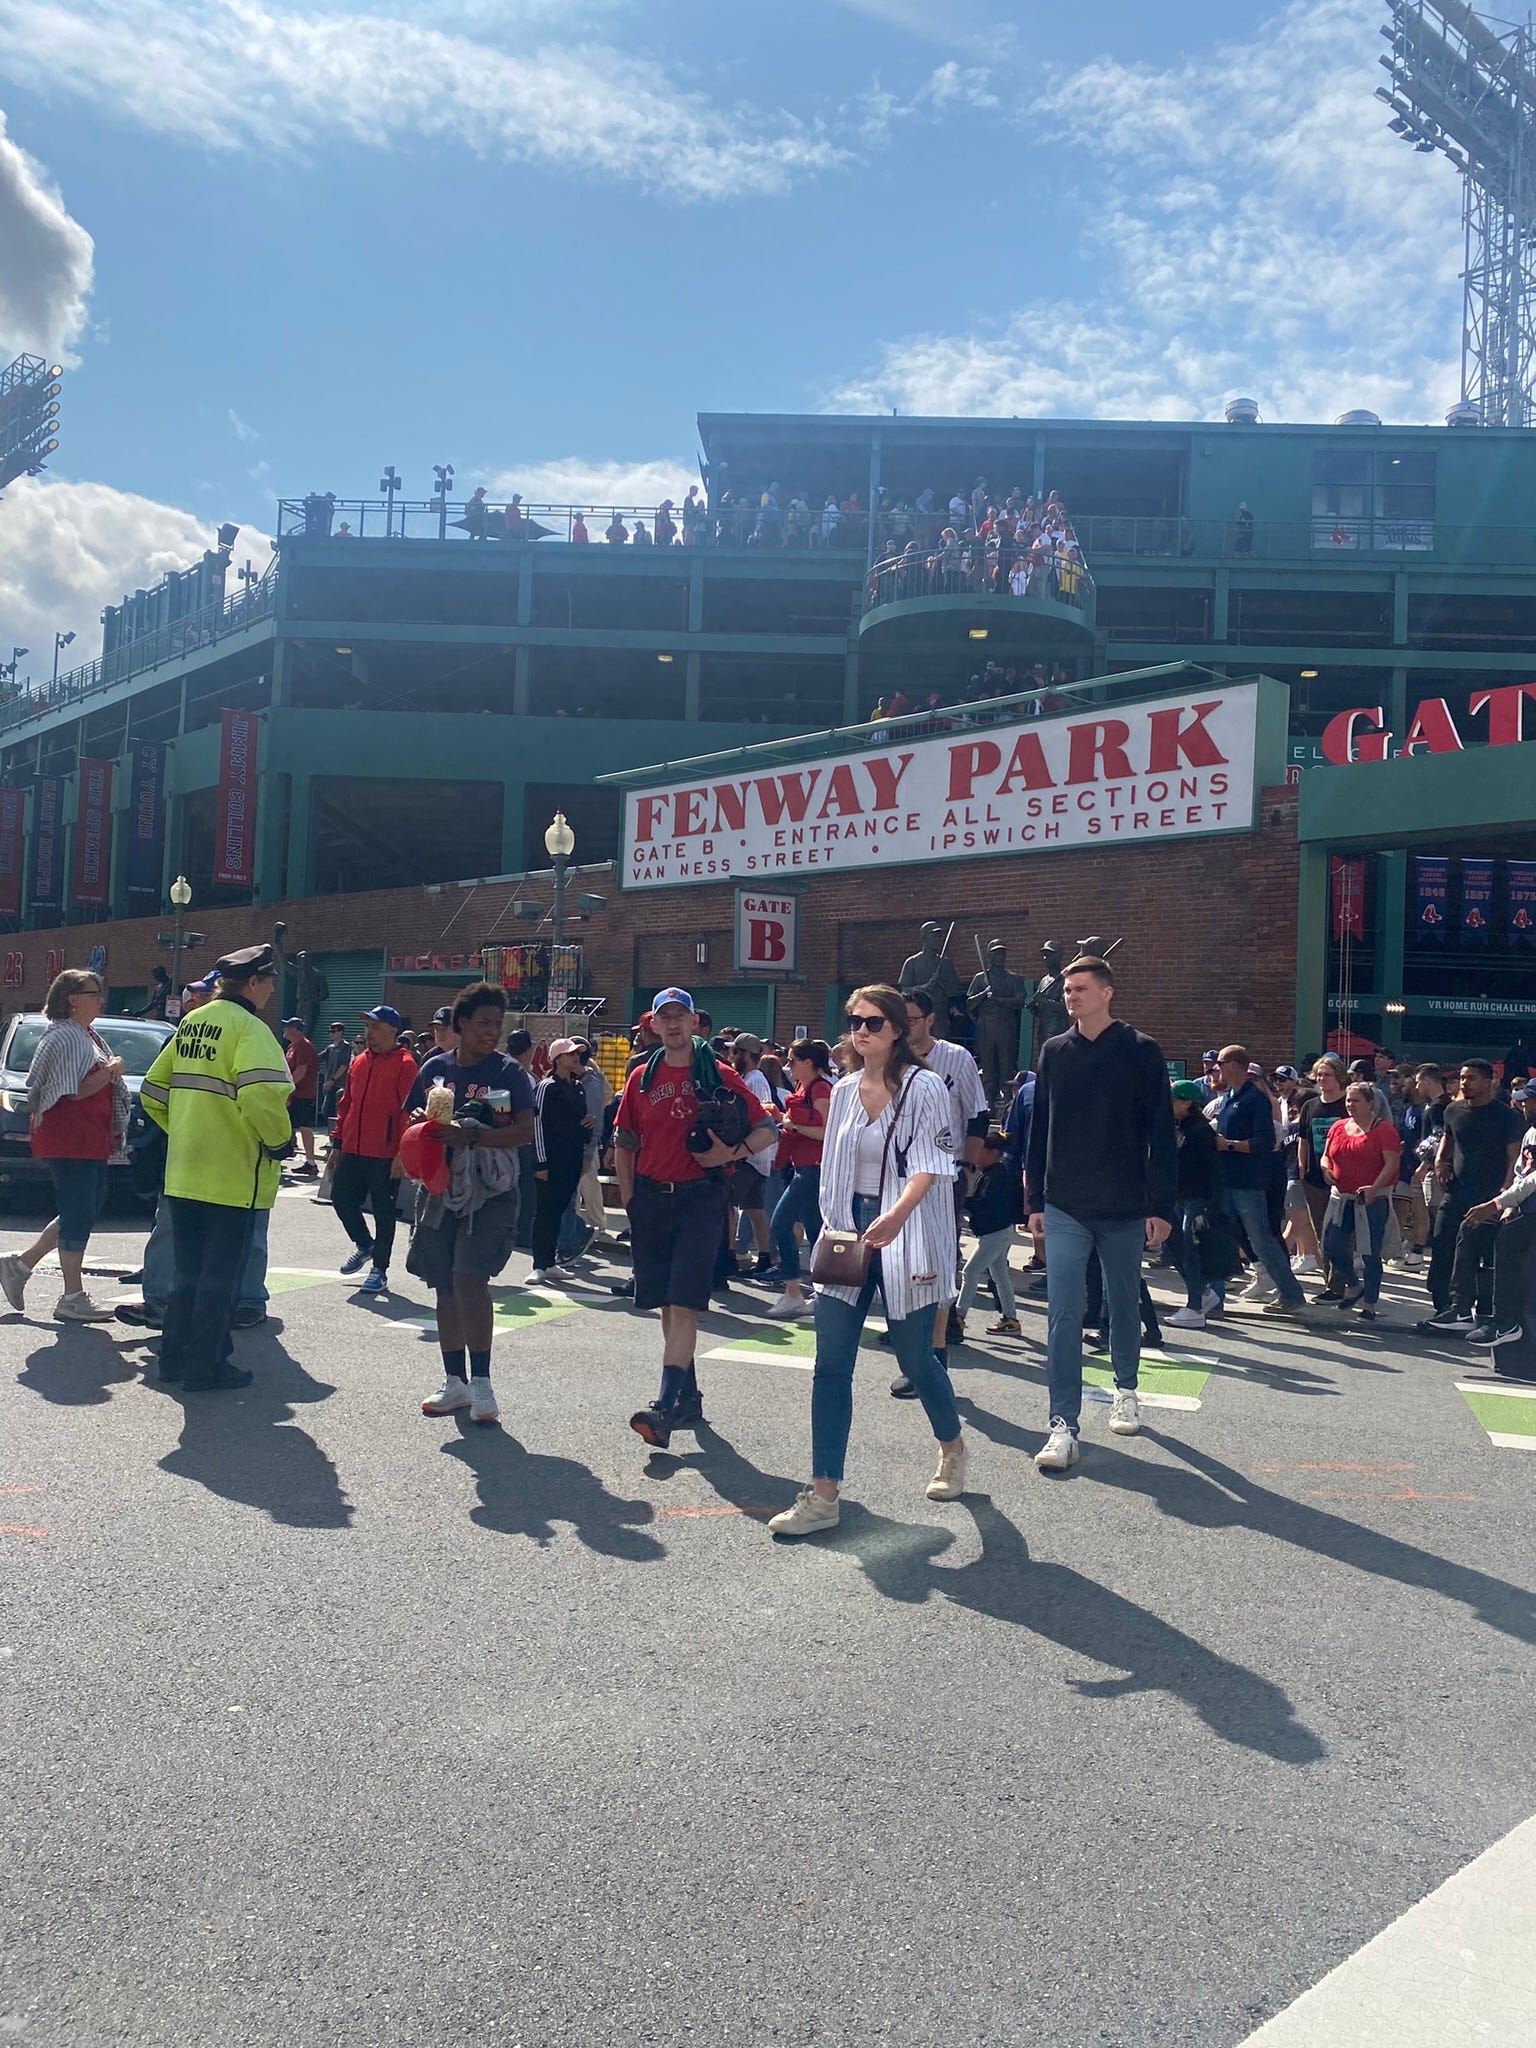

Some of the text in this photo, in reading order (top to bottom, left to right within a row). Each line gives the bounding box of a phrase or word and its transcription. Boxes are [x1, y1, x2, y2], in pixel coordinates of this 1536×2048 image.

[231, 714, 248, 785] JIMMY
[634, 700, 1229, 843] FENWAY PARK
[138, 745, 158, 839] CY YOUNG
[633, 773, 1229, 863] GATE B ENTRANCE ALL SECTIONS
[83, 808, 101, 883] SPEAKER
[225, 788, 245, 870] COLLINS
[633, 802, 1228, 881] VAN NESS STREET IPSWICH STREET
[743, 898, 792, 914] GATE
[747, 918, 786, 961] B
[177, 1020, 222, 1040] Boston
[1428, 1000, 1442, 1009] VR
[1443, 1001, 1469, 1010] HOME
[1470, 1002, 1489, 1011] RUN
[649, 1081, 675, 1106] RED
